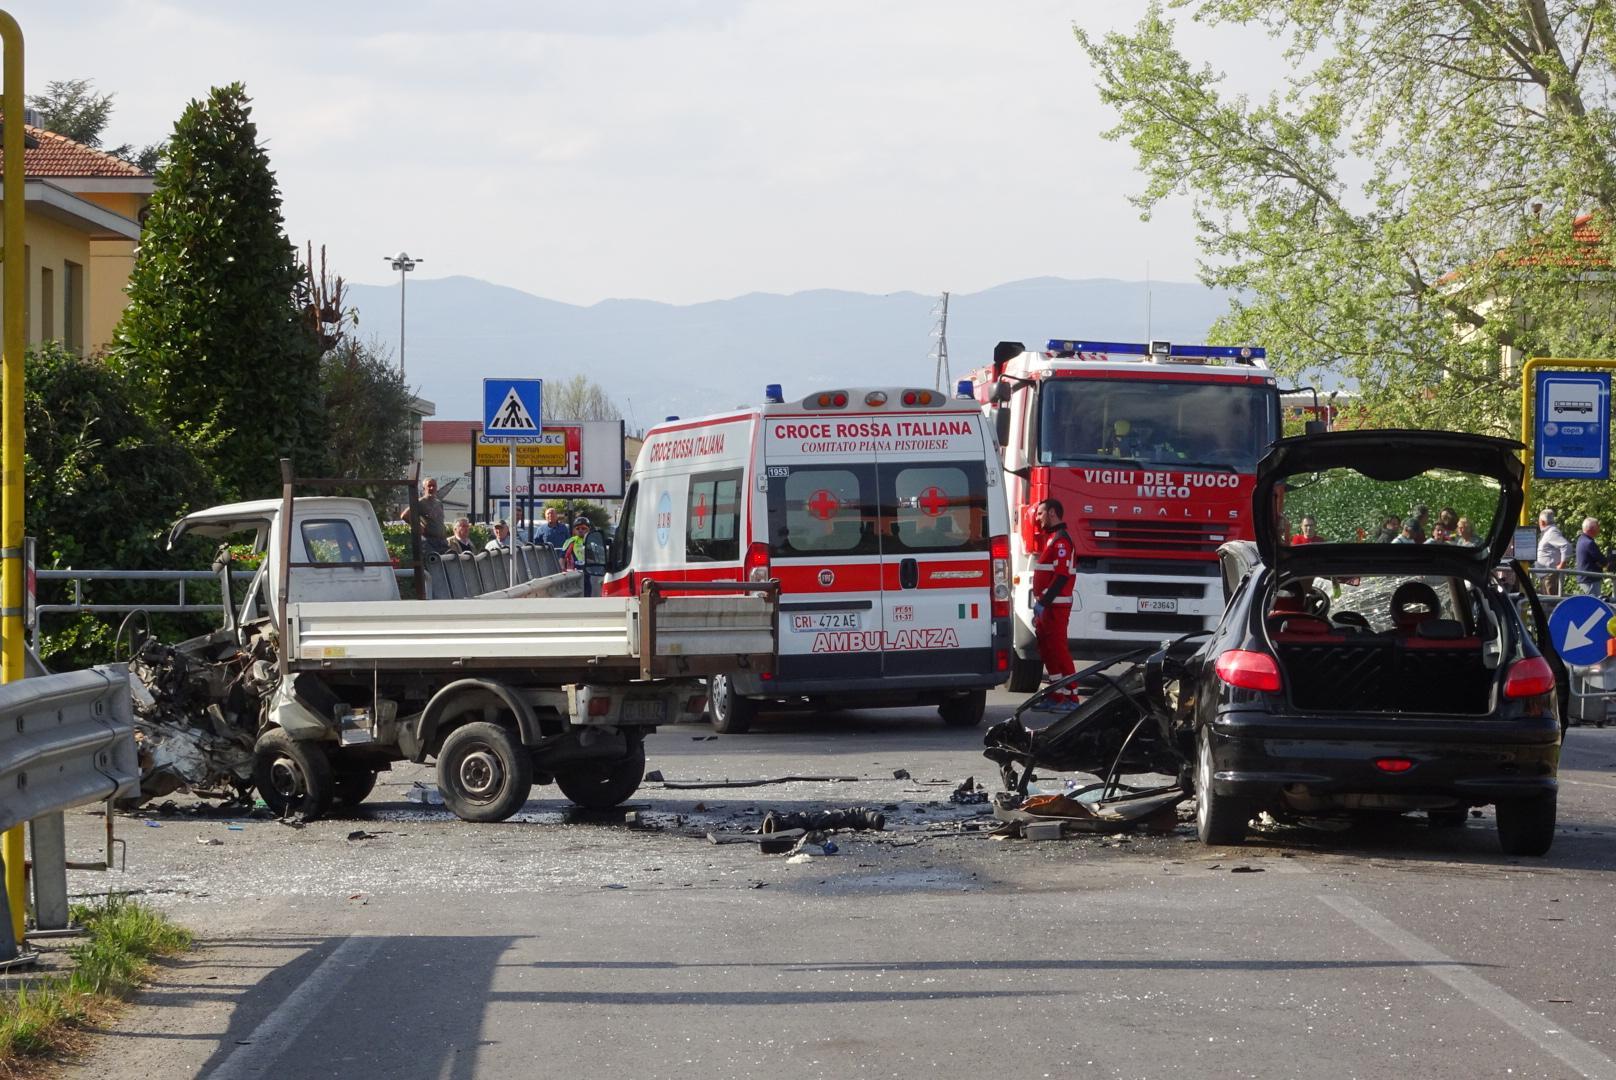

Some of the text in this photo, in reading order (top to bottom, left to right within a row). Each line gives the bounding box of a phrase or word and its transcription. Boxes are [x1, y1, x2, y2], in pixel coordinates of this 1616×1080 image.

[775, 421, 972, 439] CROCE ROSSA ITALIANA
[650, 433, 725, 463] CROCE ROSSA ITALIANA
[801, 439, 949, 453] COMITATO PIANA PISTOIESE
[769, 468, 788, 476] 1953
[1084, 470, 1240, 488] VIGILI DEL FUOCO
[538, 483, 606, 493] QUARRATA
[1137, 486, 1191, 498] IVECO
[1084, 505, 1238, 518] STRALIS
[812, 628, 960, 653] AMBULANZA
